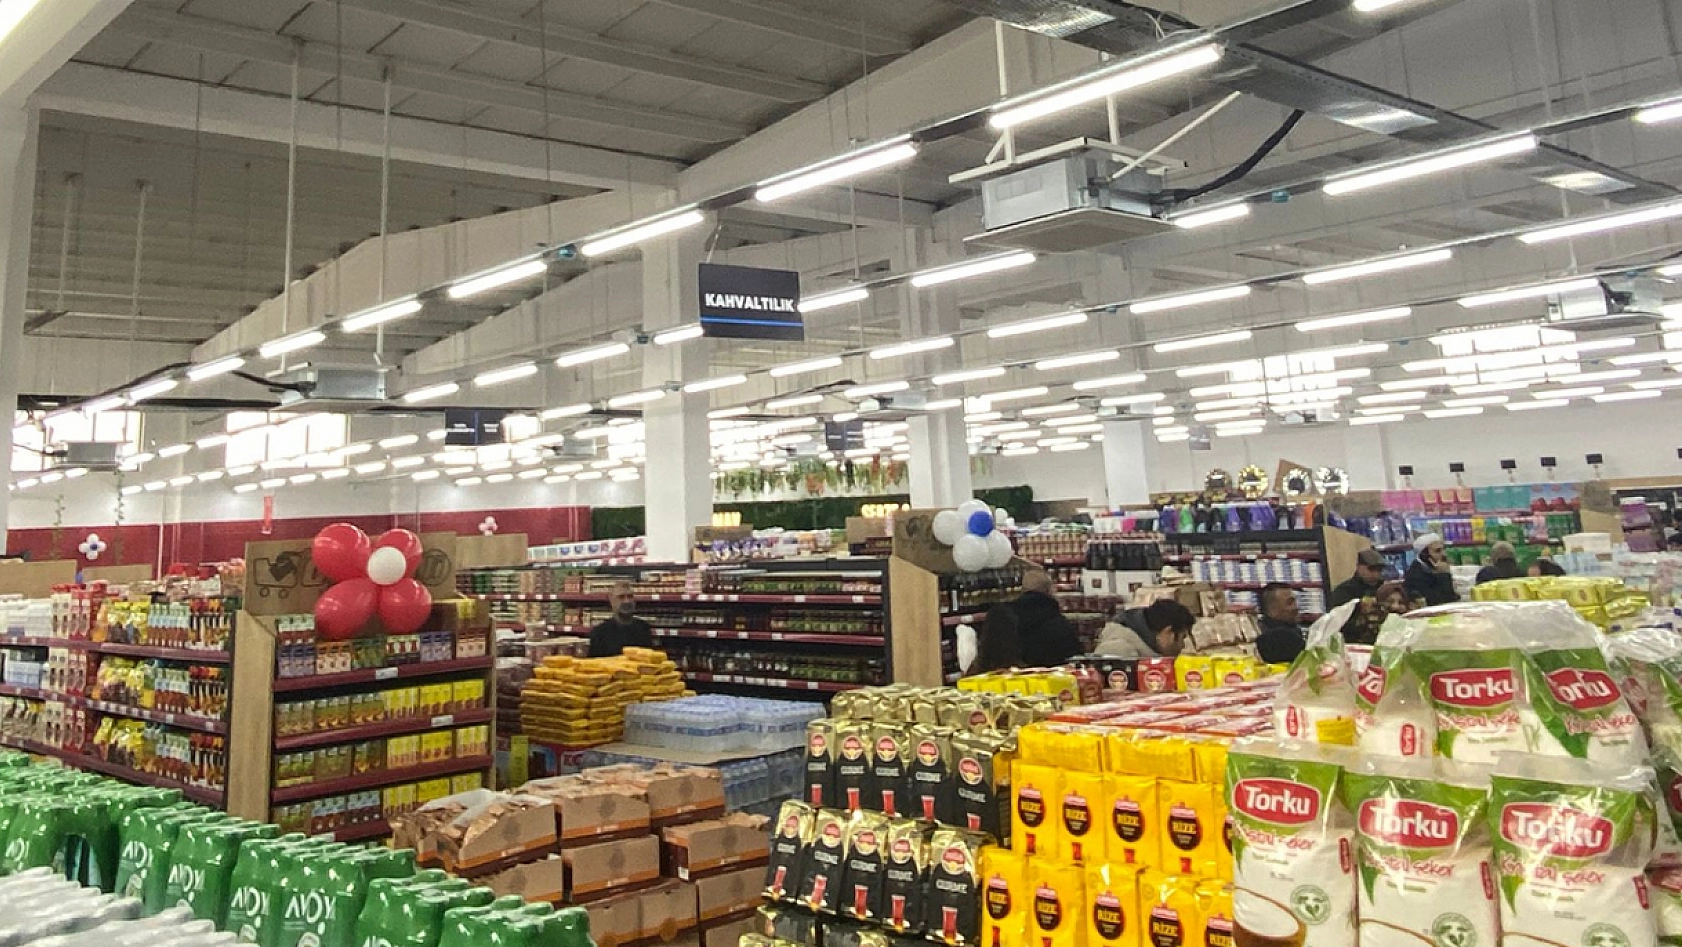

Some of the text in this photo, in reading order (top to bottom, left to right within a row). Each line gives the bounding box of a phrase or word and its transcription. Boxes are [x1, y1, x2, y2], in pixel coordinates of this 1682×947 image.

[705, 293, 795, 312] KAHVALTILIK
[1439, 677, 1519, 700] Torku
[1551, 673, 1612, 702] orku
[1243, 786, 1311, 815] Torku
[1369, 805, 1448, 839] Torku
